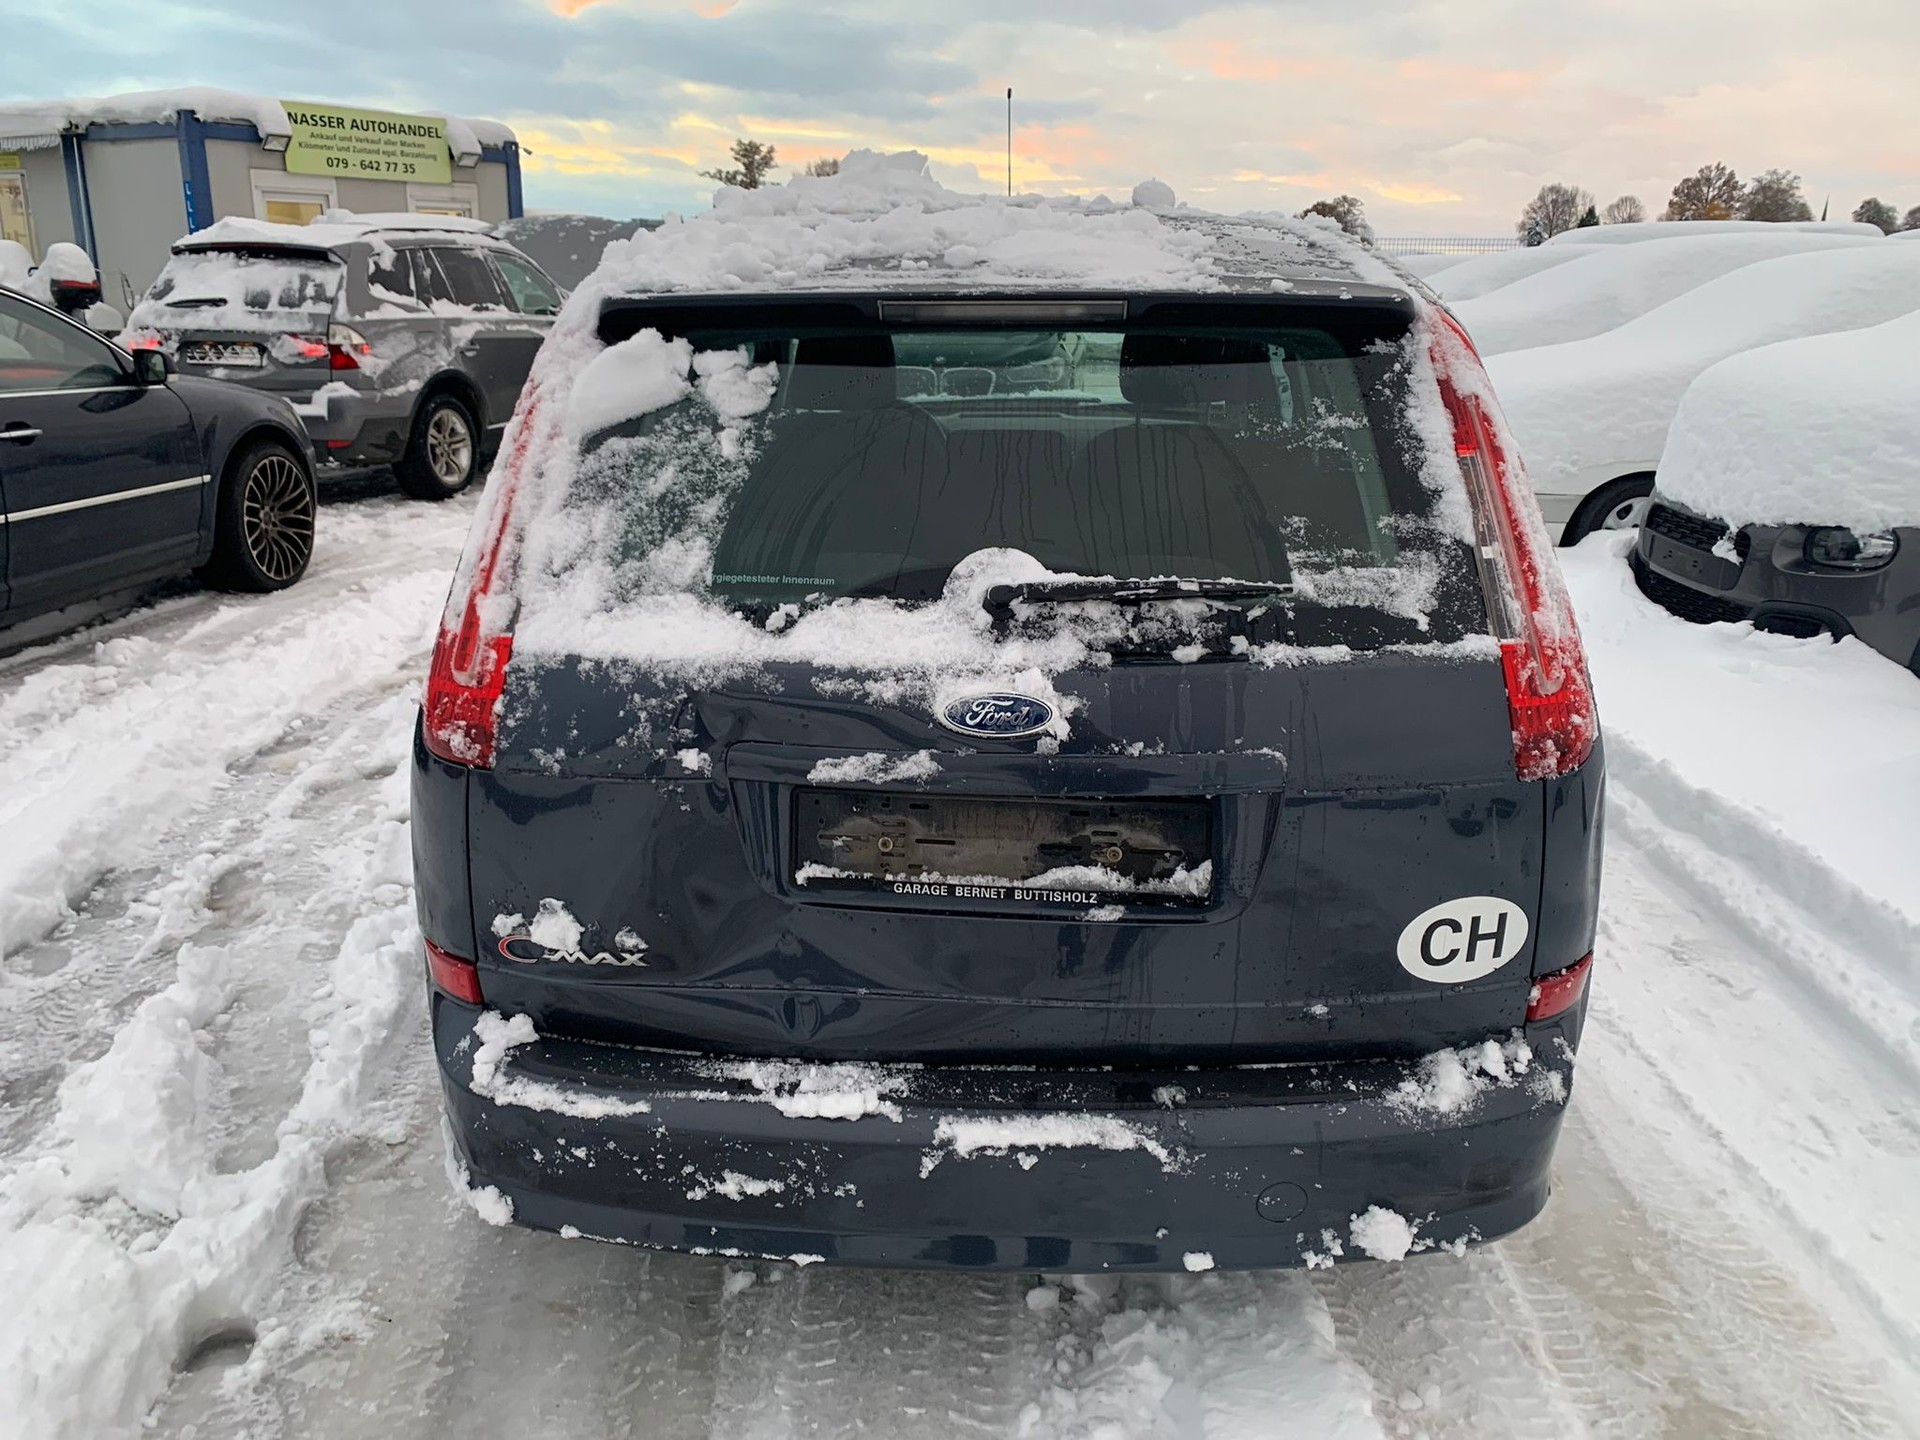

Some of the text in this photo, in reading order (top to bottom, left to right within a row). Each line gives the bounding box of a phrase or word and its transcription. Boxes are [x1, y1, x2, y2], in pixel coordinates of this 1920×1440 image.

[287, 111, 442, 139] NASSER AUTOHANDEL
[310, 131, 425, 149] Ankauf und Verkauf aller Marken
[298, 141, 334, 151] Kilometer
[336, 145, 351, 153] und
[352, 145, 380, 155] Zustand
[400, 149, 438, 162] Barzahlung
[326, 156, 349, 169] 079
[359, 159, 381, 172] 642
[384, 161, 398, 172] 77
[402, 162, 416, 174] 35
[782, 575, 835, 585] Innenraum
[965, 699, 1031, 726] Ford
[893, 882, 1098, 904] GARAGE BERNET BUTTISHOLZ
[1420, 912, 1508, 966] CH
